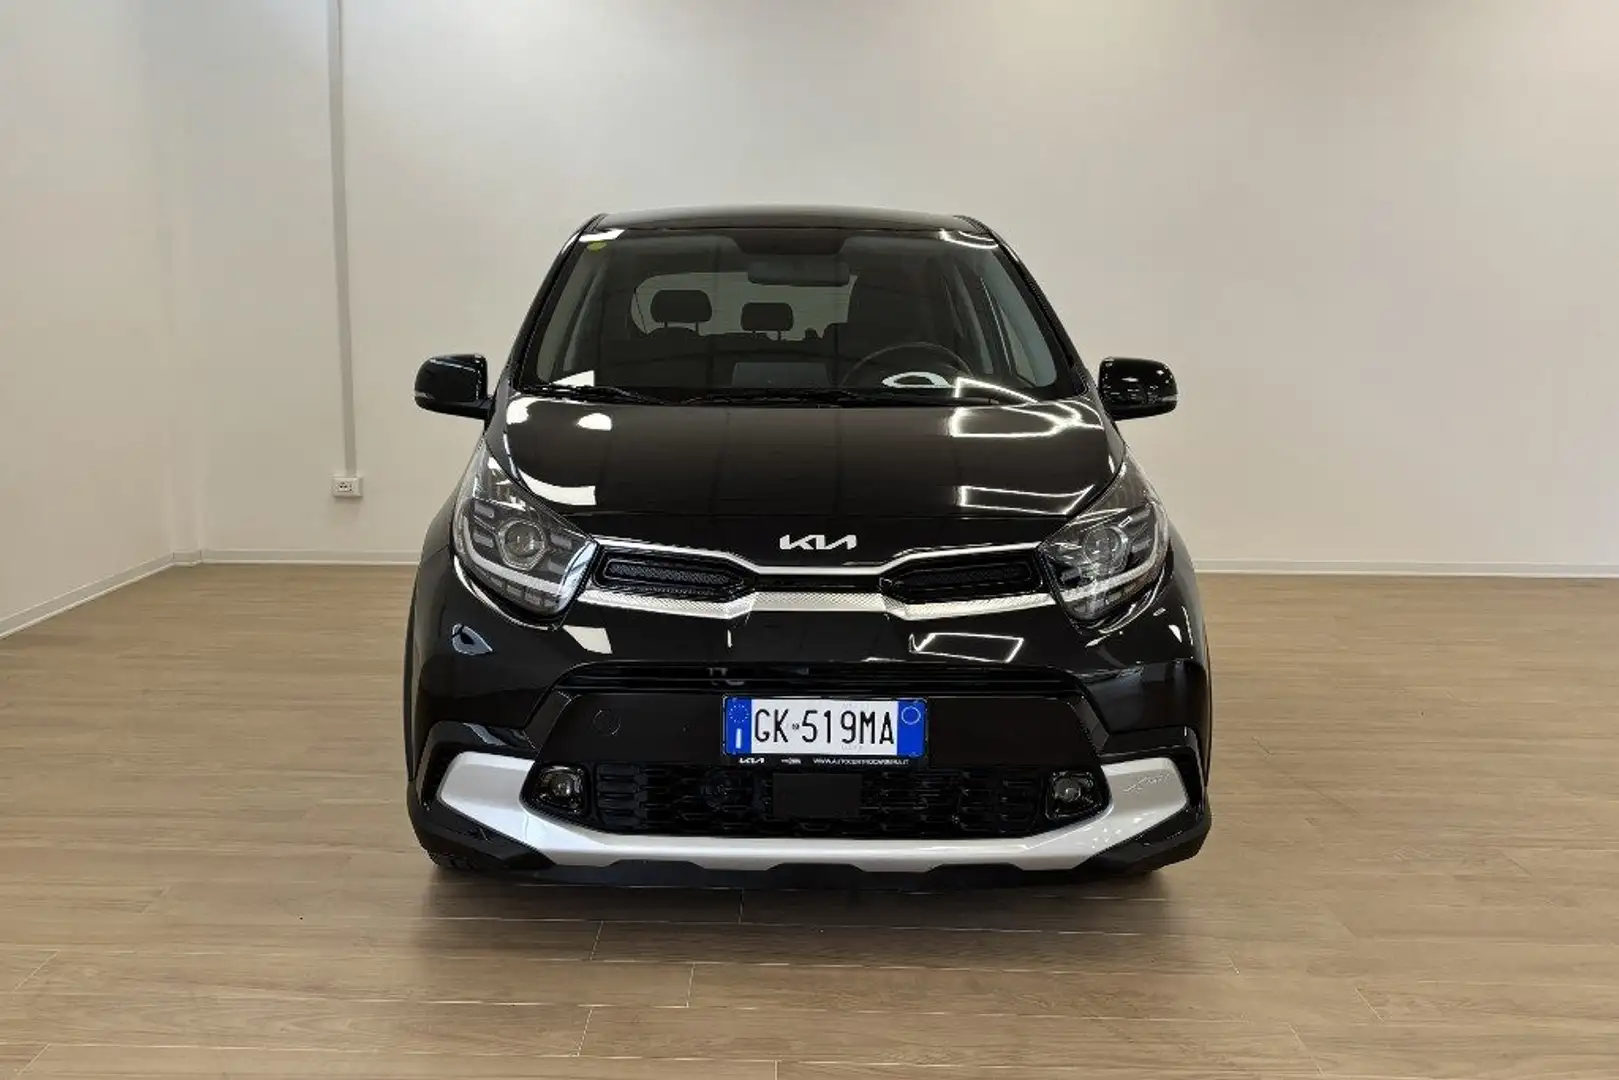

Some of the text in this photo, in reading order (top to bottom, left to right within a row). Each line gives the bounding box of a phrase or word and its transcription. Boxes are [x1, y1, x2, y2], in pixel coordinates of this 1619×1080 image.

[779, 534, 857, 550] KIA
[754, 708, 895, 745] GK 519MA
